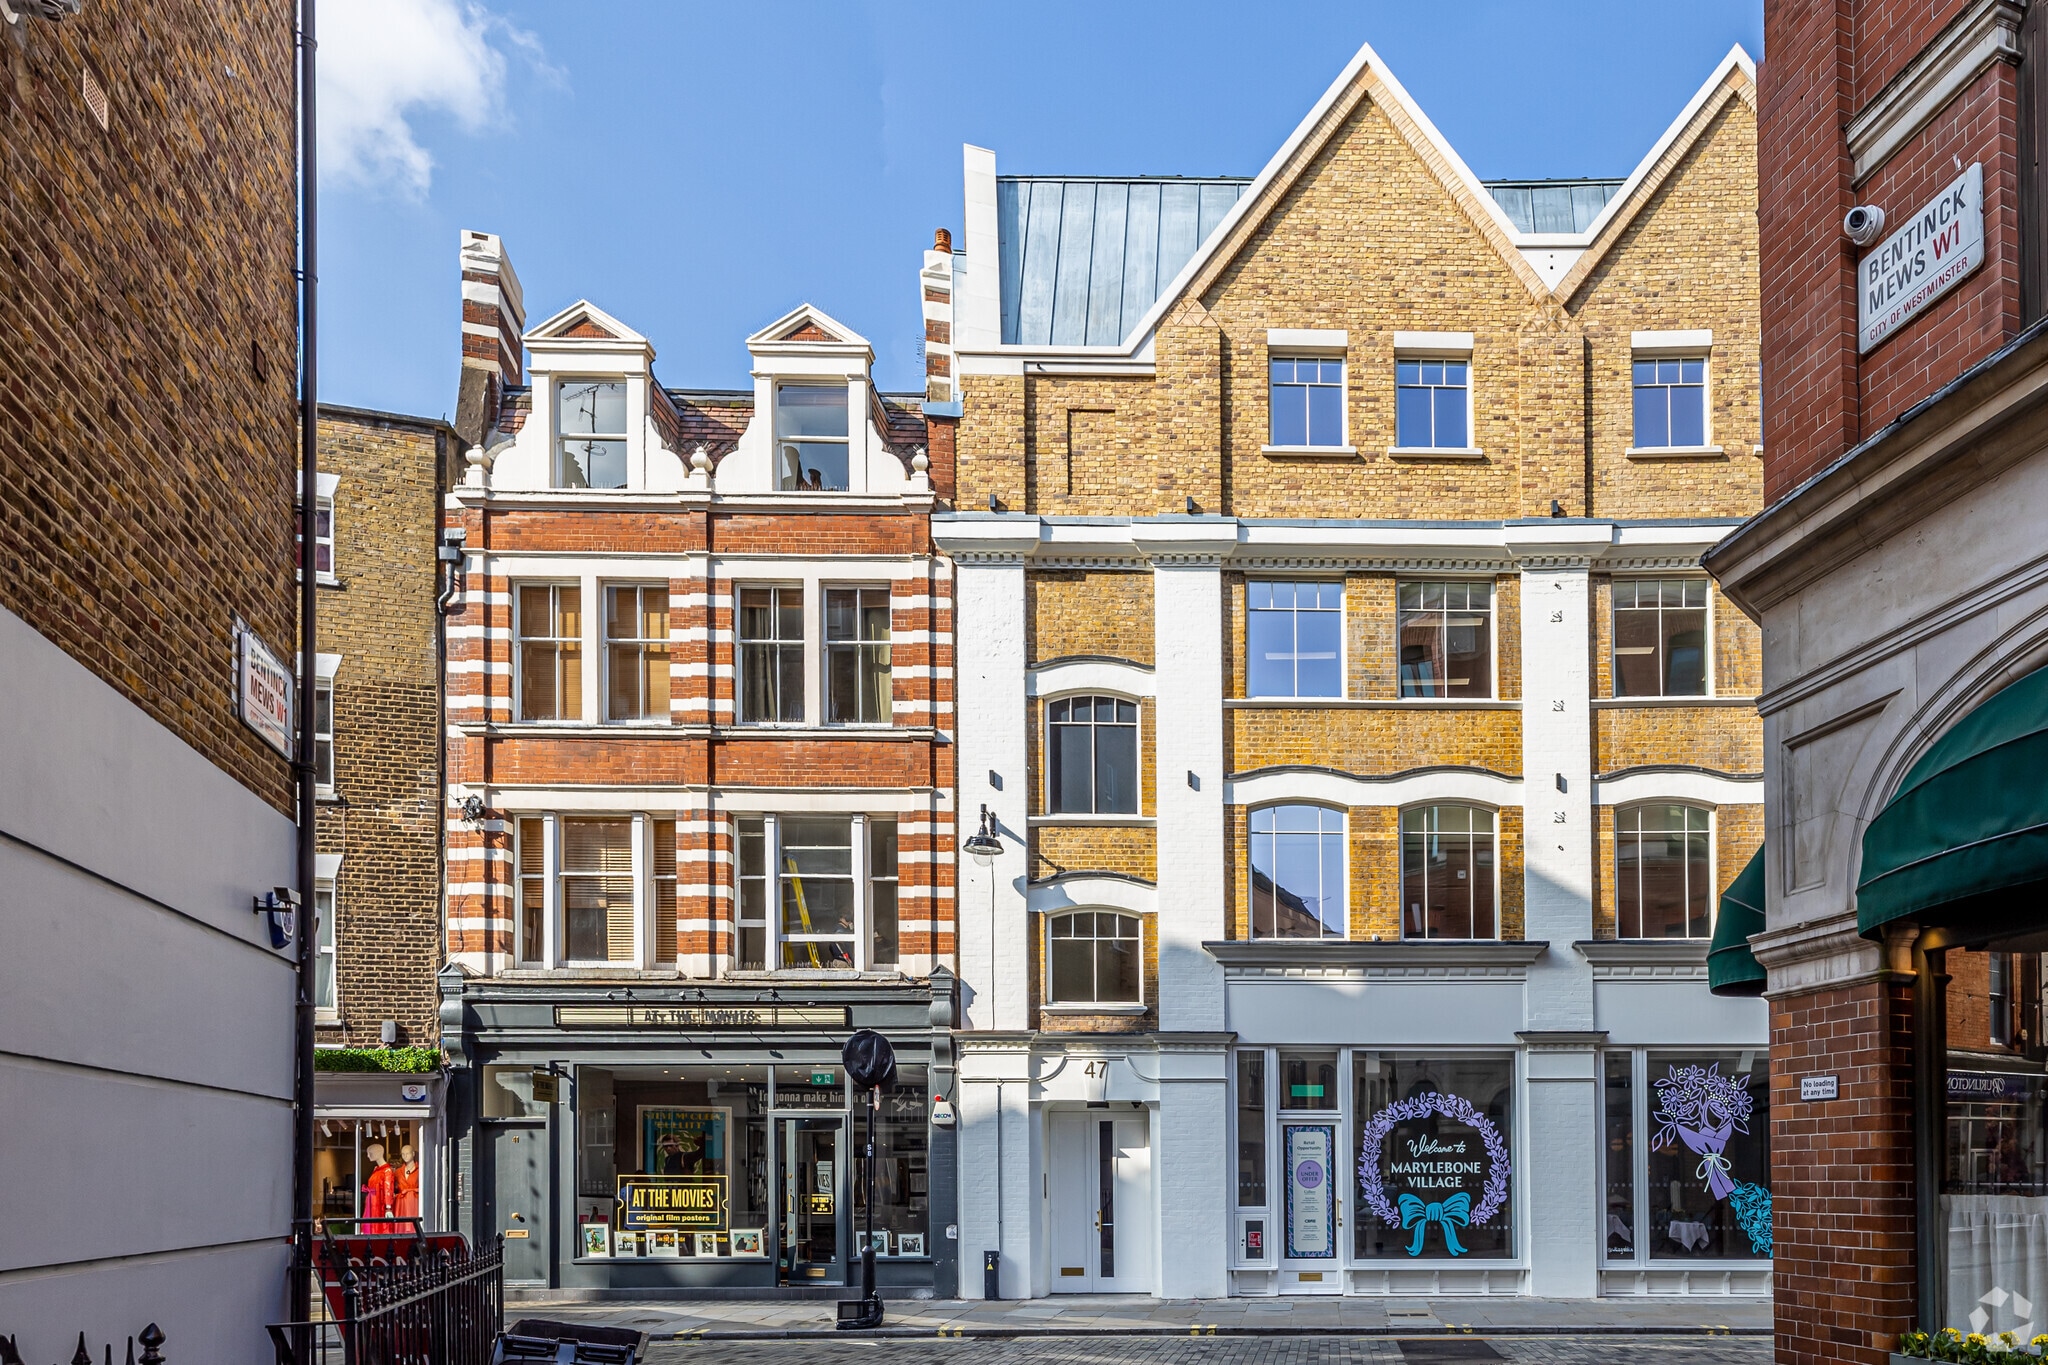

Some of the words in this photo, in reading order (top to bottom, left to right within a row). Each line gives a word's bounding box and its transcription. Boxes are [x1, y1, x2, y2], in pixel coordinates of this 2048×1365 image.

[1869, 183, 1966, 285] BENTINCK
[1869, 249, 1925, 315] MEWS
[1933, 220, 1960, 261] W1
[1870, 318, 1888, 341] CITY
[1890, 307, 1901, 325] OF
[1903, 257, 1968, 313] WESTMINSTER
[251, 648, 287, 702] BENTINCK
[250, 675, 274, 715] MEWS
[276, 698, 287, 728] W1
[1084, 1061, 1108, 1079] 47
[775, 1092, 800, 1104] gonna
[803, 1091, 827, 1102] make
[1407, 1134, 1453, 1158] Welcome
[1453, 1140, 1466, 1153] to
[1391, 1162, 1481, 1173] MARYLEBONE
[1408, 1176, 1462, 1188] VILLAGE
[632, 1188, 646, 1208] AT
[648, 1188, 669, 1208] THE
[672, 1188, 714, 1208] MOVIES
